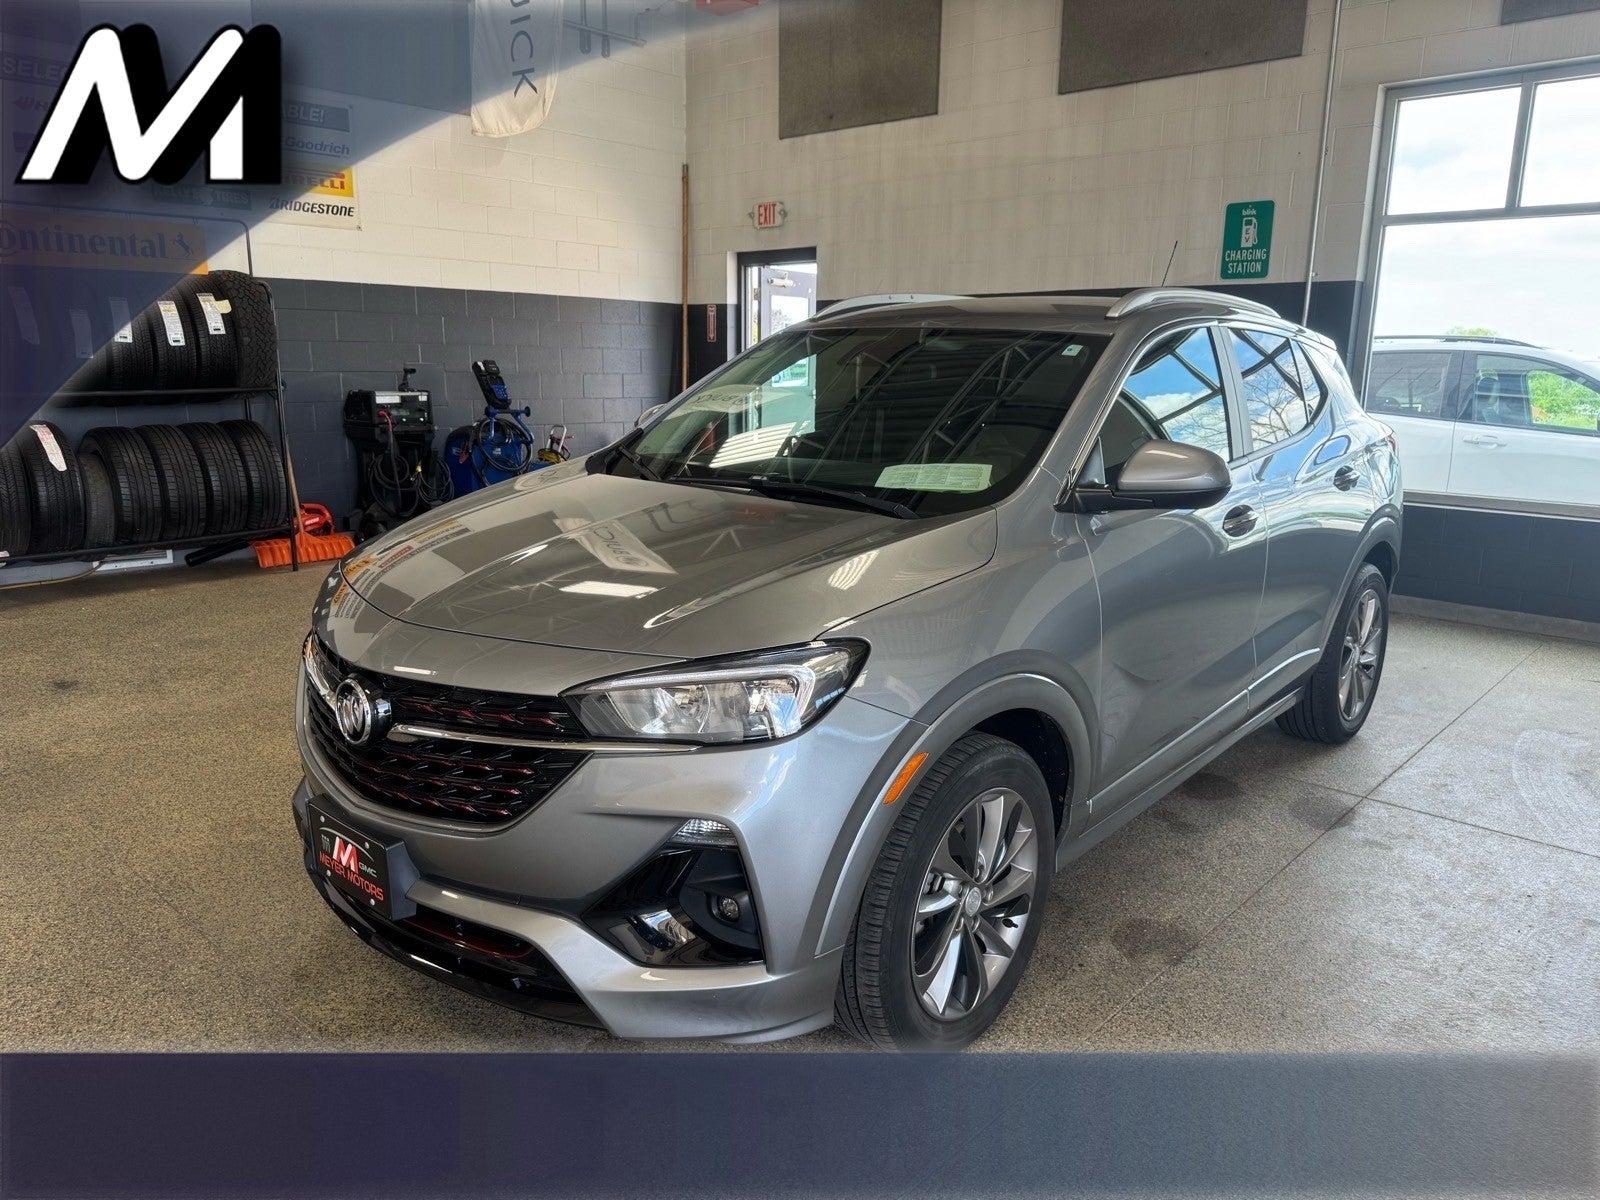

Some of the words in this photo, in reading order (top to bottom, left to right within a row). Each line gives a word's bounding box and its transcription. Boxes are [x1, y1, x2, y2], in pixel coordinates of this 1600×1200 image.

[269, 198, 355, 217] BRIDGESTONE
[758, 203, 777, 225] EXIT
[1242, 208, 1257, 216] blink
[1225, 248, 1267, 261] CHARGING
[1228, 261, 1262, 274] STATION
[320, 850, 346, 878] MEYER
[347, 868, 384, 901] MOTORS
[359, 861, 378, 878] GMC
